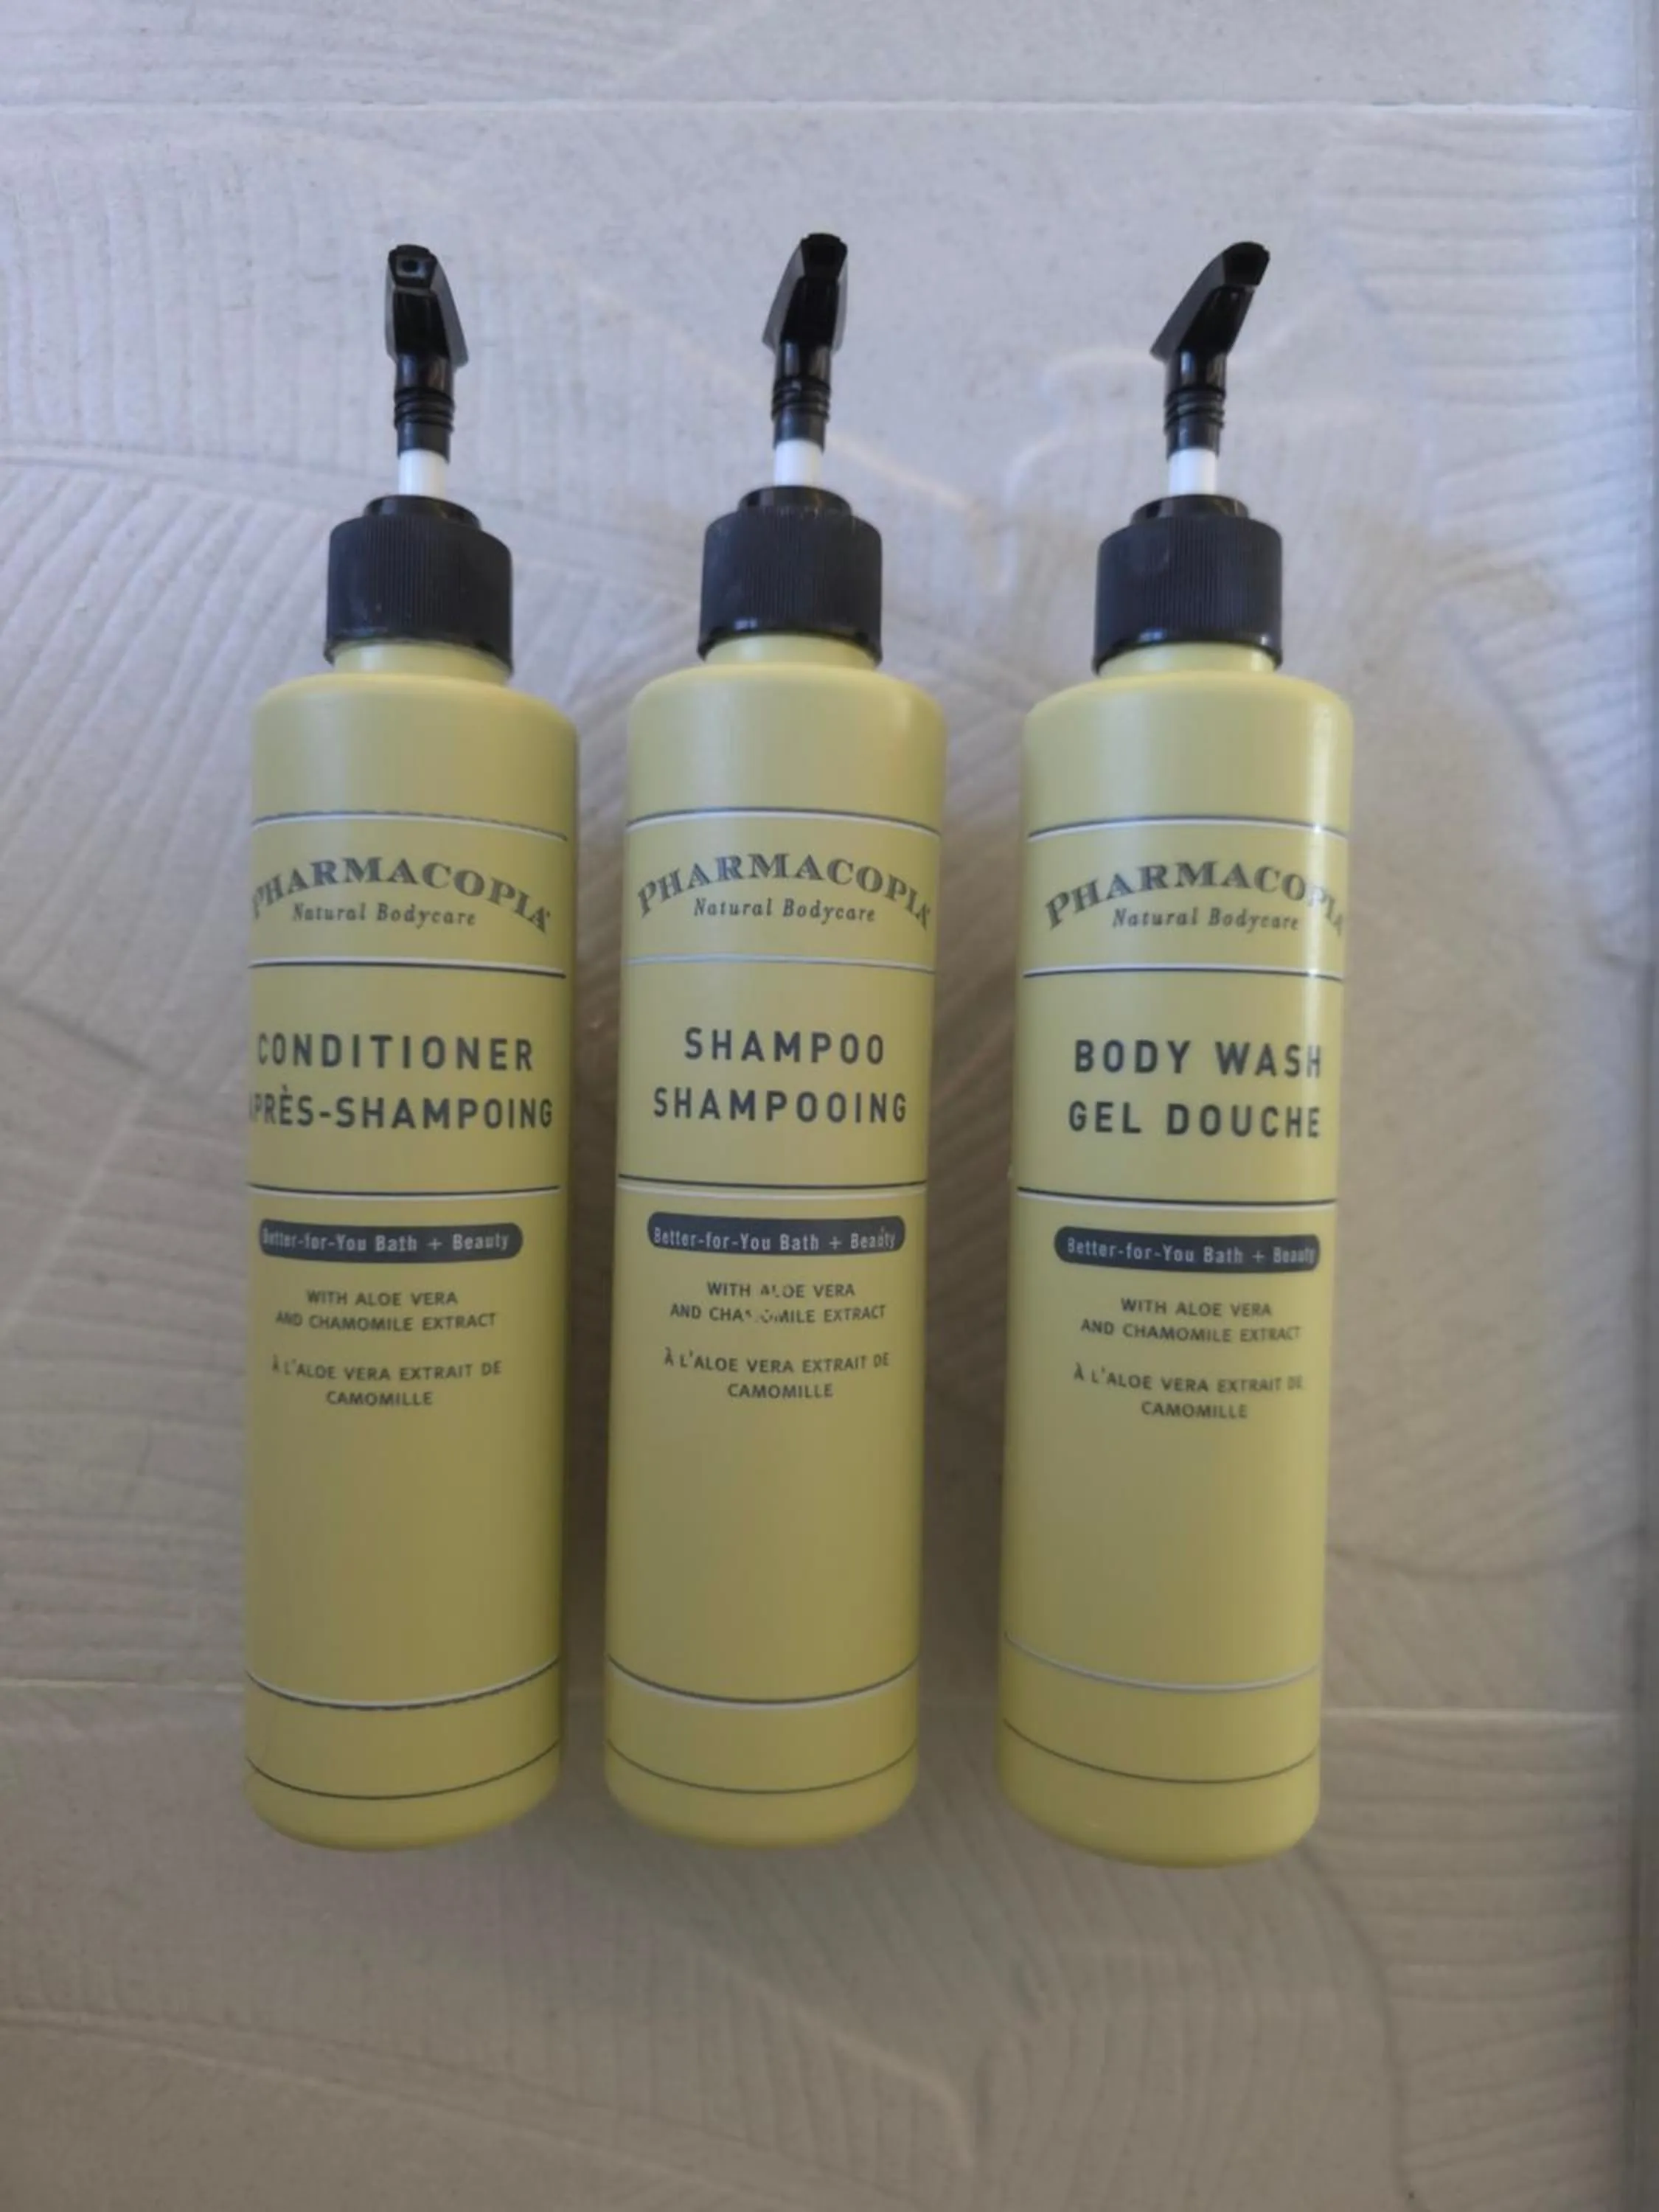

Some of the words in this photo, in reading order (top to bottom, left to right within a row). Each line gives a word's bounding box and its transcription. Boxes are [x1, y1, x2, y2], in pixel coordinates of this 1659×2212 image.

[252, 856, 548, 933] PHARMACOPIA
[637, 853, 929, 931] PHARMACOPIA
[293, 902, 366, 921] Natural
[377, 903, 476, 929] Bodycare
[694, 897, 772, 917] Natural
[783, 898, 875, 925] Bodycare
[1113, 907, 1199, 928] Natural
[1208, 908, 1299, 933] Bodycare
[258, 1032, 533, 1071] CONDITIONER
[684, 1027, 883, 1065] SHAMPOO
[1074, 1039, 1191, 1074] BODY
[1215, 1041, 1321, 1079] WASH
[249, 1083, 552, 1129] PRÈS-SHAMPOING
[653, 1087, 906, 1123] SHAMPOOING
[1069, 1101, 1141, 1134] GEL
[1166, 1103, 1319, 1138] DOUCHE
[262, 1228, 366, 1251] Better-for-You
[375, 1234, 417, 1252] Bath
[452, 1233, 509, 1251] Beauty
[654, 1227, 771, 1251] Better-for-You
[780, 1234, 819, 1251] Bath
[850, 1232, 896, 1250] Beauty
[1067, 1237, 1194, 1262] Better-for-You
[1203, 1246, 1243, 1264] Bath
[1273, 1245, 1316, 1265] Beauty
[307, 1290, 347, 1306] WITH
[355, 1292, 401, 1307] ALOE
[411, 1292, 458, 1306] VERA
[706, 1281, 751, 1297] WITH
[813, 1284, 855, 1298] VERA
[670, 1304, 701, 1320] AND
[824, 1304, 886, 1324] EXTRACT
[1121, 1298, 1167, 1315] WITH
[1175, 1301, 1222, 1317] ALOE
[1231, 1302, 1272, 1317] VERA
[276, 1311, 302, 1326] AND
[309, 1315, 412, 1332] CHAMOMILE
[422, 1312, 496, 1330] EXTRACT
[1080, 1318, 1114, 1335] AND
[1123, 1323, 1231, 1343] CHAMOMILE
[1240, 1326, 1301, 1343] EXTRACT
[272, 1354, 280, 1372] À
[284, 1359, 335, 1379] L'ALOE
[344, 1366, 390, 1381] VERA
[400, 1363, 473, 1381] EXTRAIT
[481, 1361, 502, 1375] DE
[664, 1347, 673, 1366] À
[681, 1351, 737, 1372] L'ALOE
[747, 1360, 794, 1374] VERA
[802, 1354, 867, 1374] EXTRAIT
[873, 1352, 889, 1367] DE
[728, 1383, 834, 1399] CAMOMILLE
[1074, 1362, 1084, 1381] À
[1091, 1366, 1152, 1389] L'ALOE
[1161, 1377, 1208, 1393] VERA
[1217, 1376, 1281, 1394] EXTRAIT
[1288, 1375, 1303, 1390] DE
[327, 1391, 433, 1406] CAMOMILLE
[1141, 1401, 1248, 1419] CAMOMILLE
